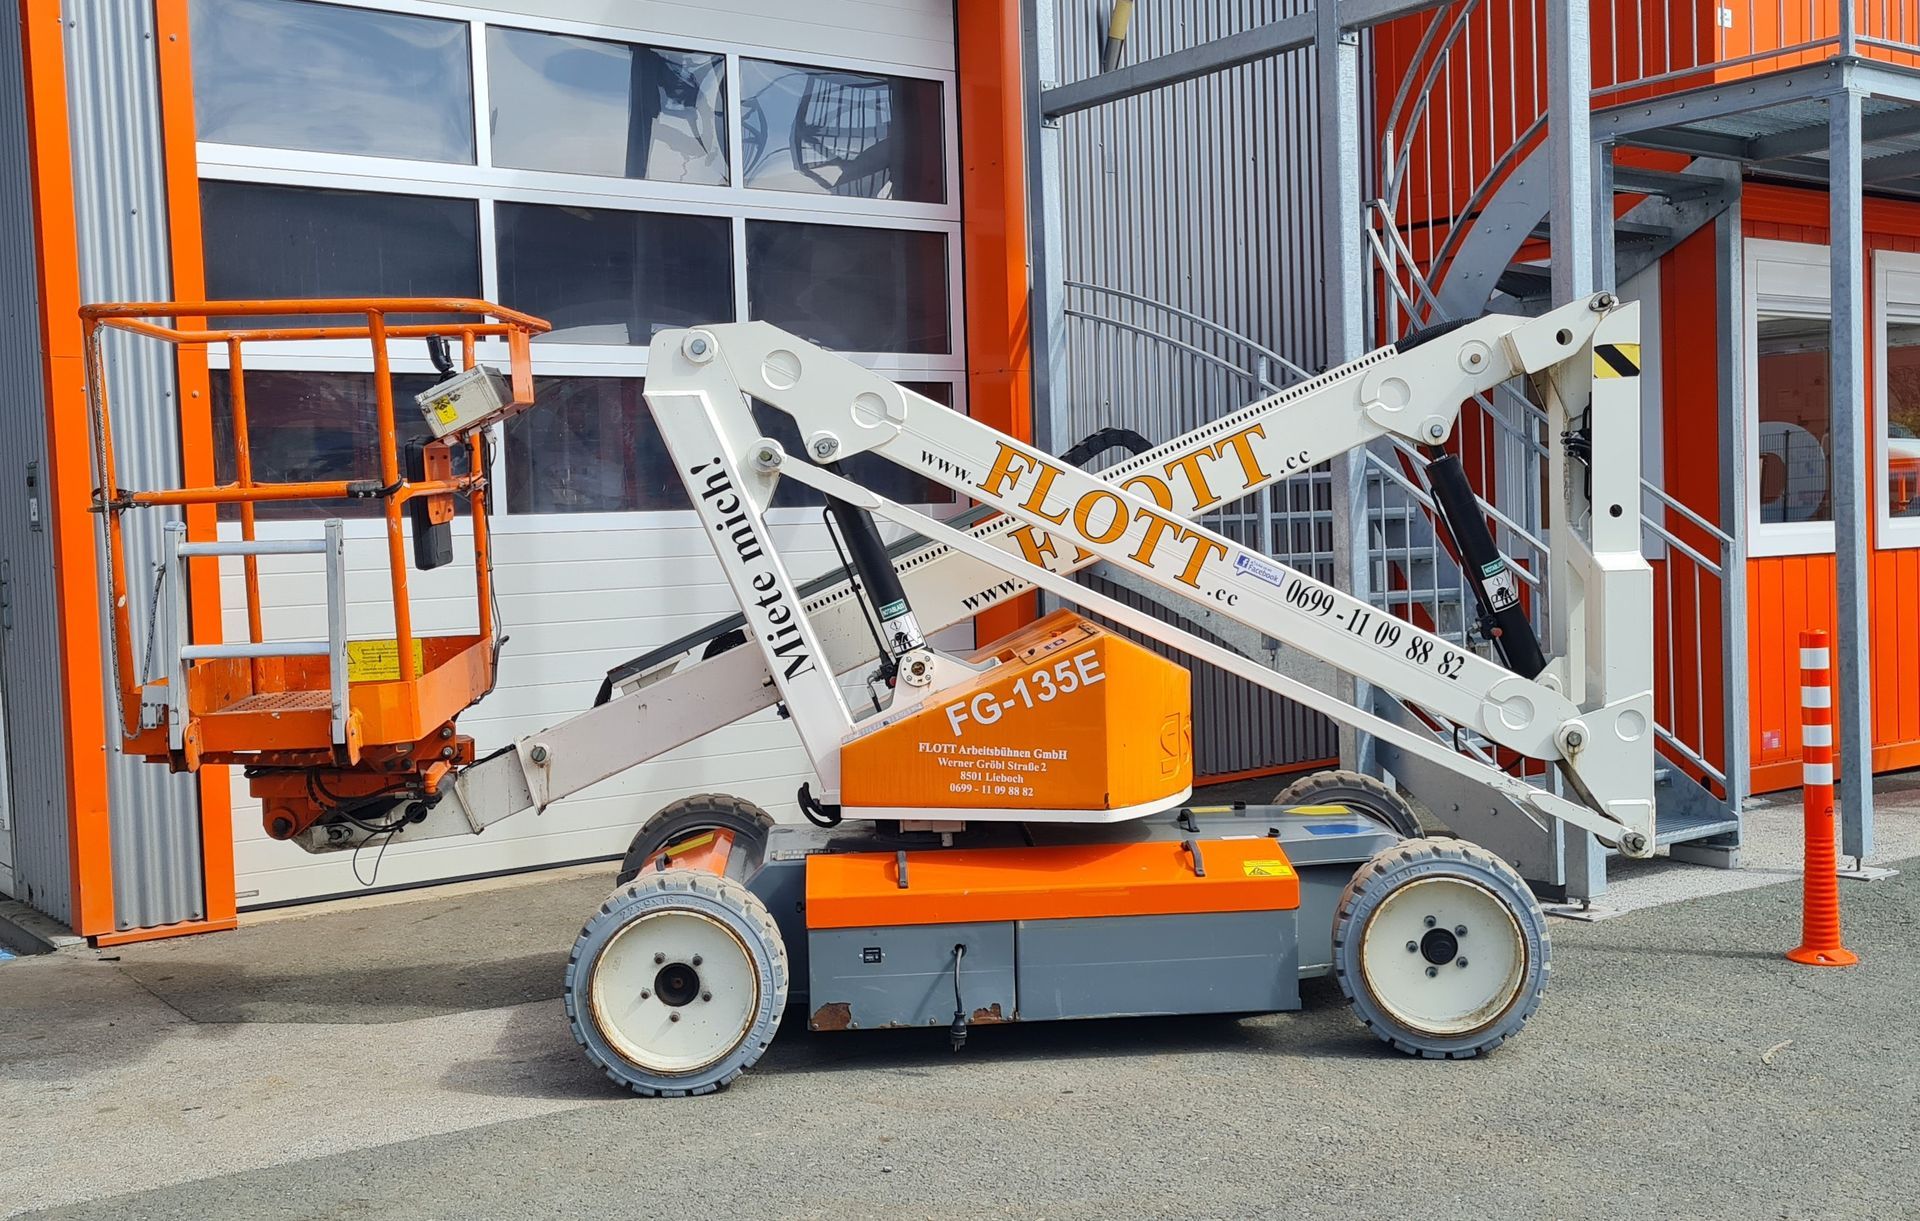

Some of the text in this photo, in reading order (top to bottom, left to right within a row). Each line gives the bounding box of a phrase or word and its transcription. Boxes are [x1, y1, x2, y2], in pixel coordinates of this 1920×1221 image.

[690, 456, 817, 684] Miete mich!
[1248, 563, 1279, 582] Facebook
[1286, 578, 1335, 617] 0699
[1374, 620, 1402, 648] 09
[1405, 635, 1434, 664] 88
[1437, 651, 1465, 681] 82
[945, 649, 1106, 737] FG-135E
[918, 742, 1068, 761] FLOTT Arbeitsbühnen GmbH
[938, 757, 1047, 772] Werner Gröbl Straße 2
[960, 771, 1024, 784] 8501 Lieboch
[949, 783, 973, 793] 0699
[982, 784, 991, 794] 11
[994, 785, 1006, 795] 09
[1008, 786, 1020, 796] 88
[1022, 787, 1034, 797] 82
